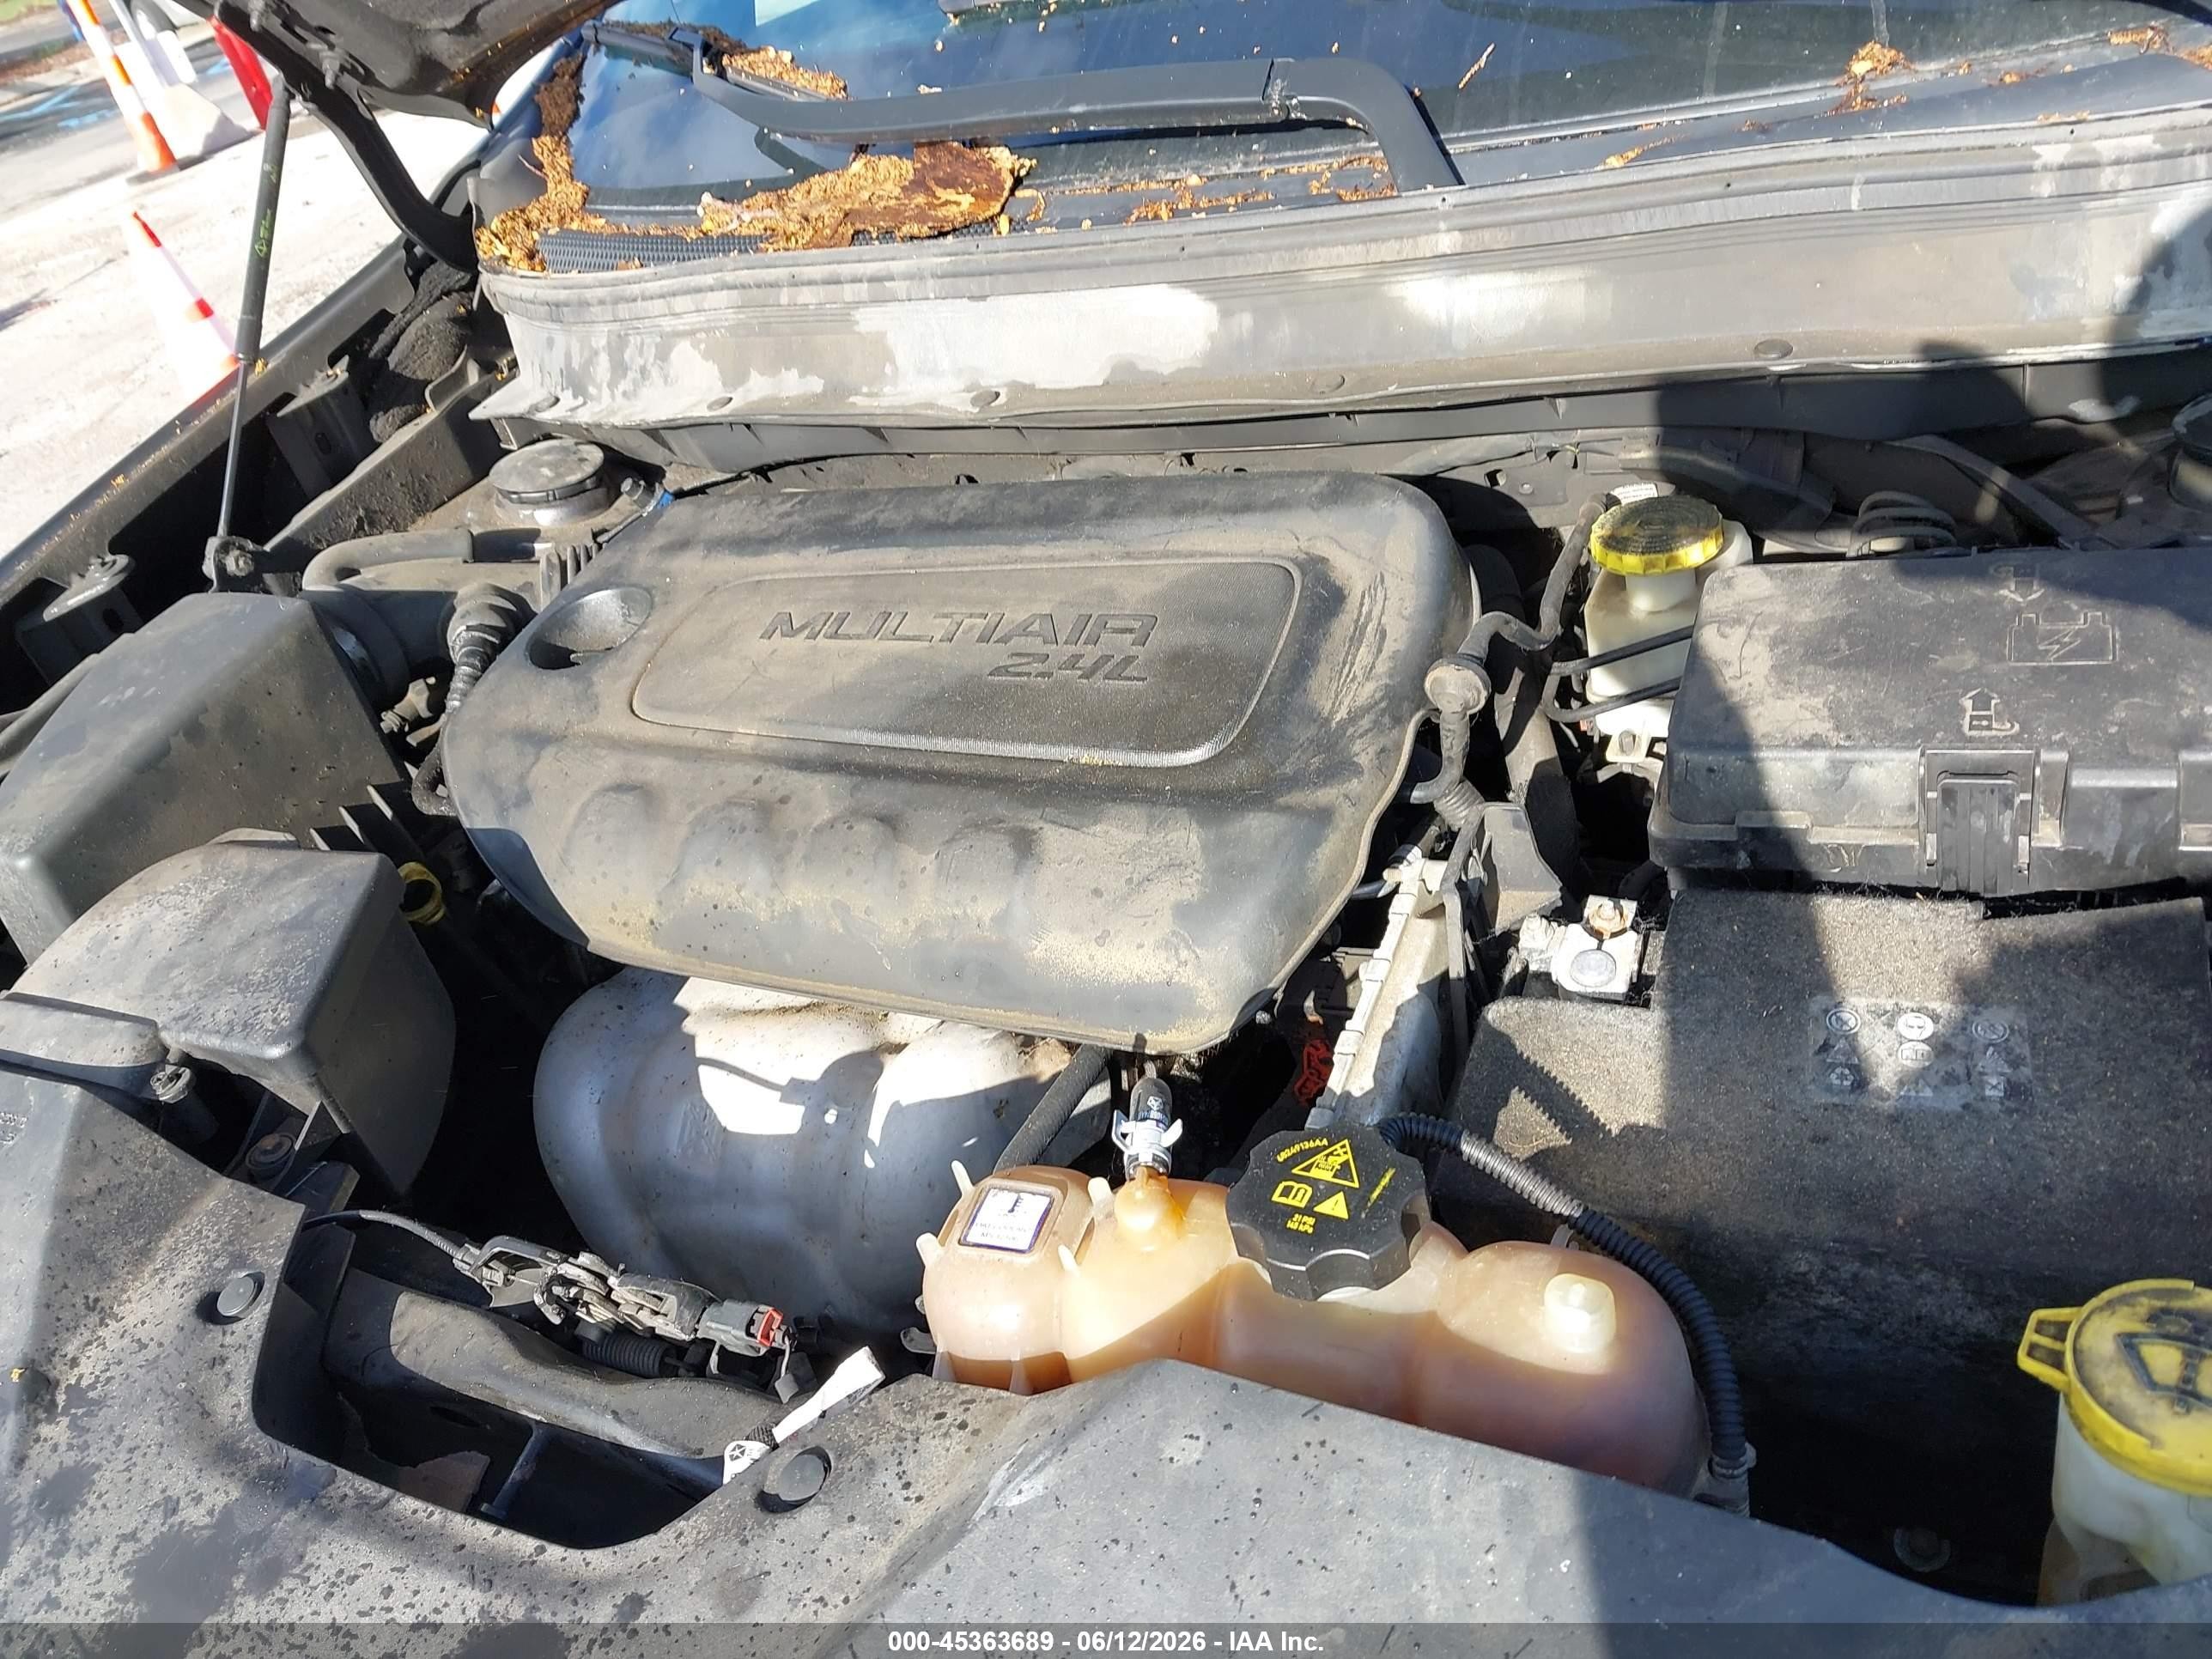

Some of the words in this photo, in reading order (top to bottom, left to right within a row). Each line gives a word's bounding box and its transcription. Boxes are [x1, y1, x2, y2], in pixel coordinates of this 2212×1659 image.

[758, 611, 1158, 647] MULTIAIR
[988, 652, 1149, 683] 2.4L
[1302, 1215, 1316, 1225] PSI
